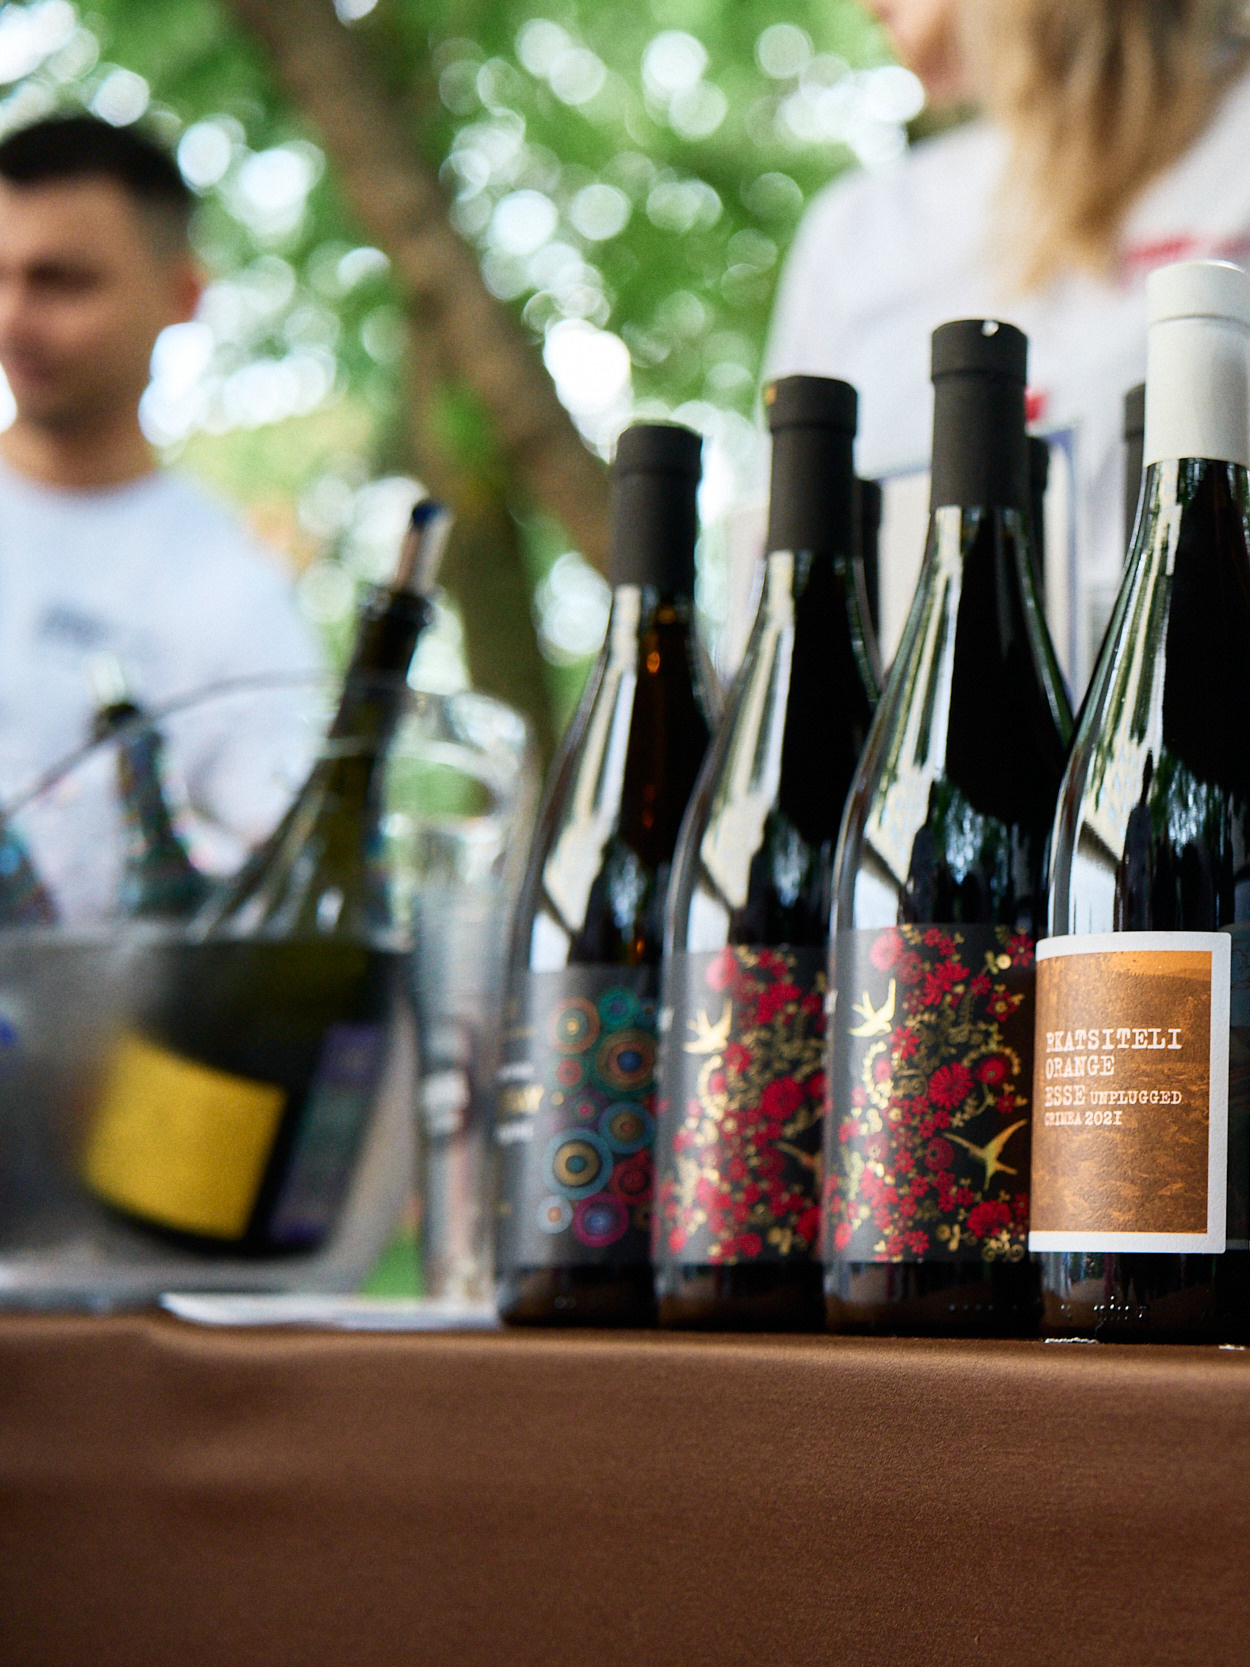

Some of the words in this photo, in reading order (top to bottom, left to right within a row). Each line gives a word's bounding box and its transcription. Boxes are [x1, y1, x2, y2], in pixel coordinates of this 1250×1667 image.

[1045, 1028, 1182, 1053] RKATSITELI
[1045, 1055, 1115, 1080] ORANGE
[1044, 1085, 1086, 1107] ESSE
[1090, 1090, 1182, 1105] UNPLUGGED
[1085, 1110, 1123, 1126] 2021
